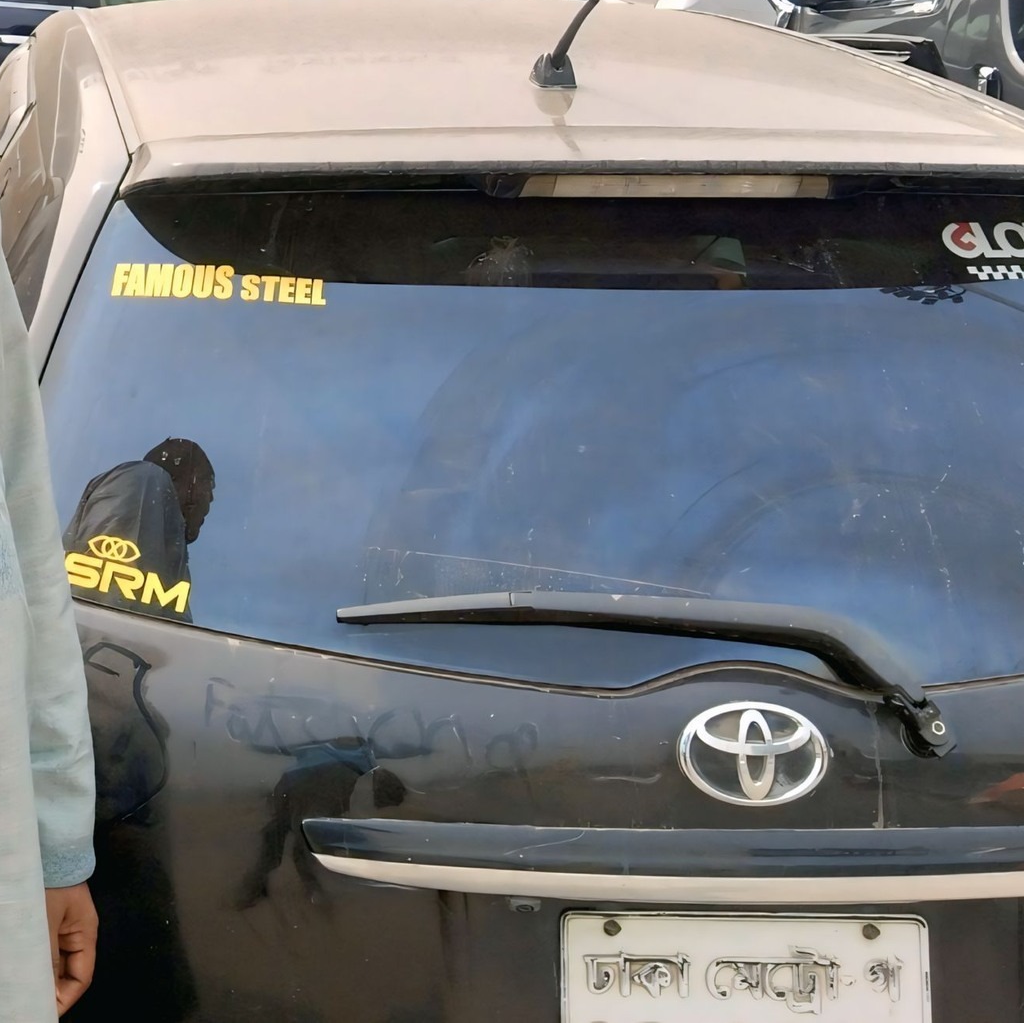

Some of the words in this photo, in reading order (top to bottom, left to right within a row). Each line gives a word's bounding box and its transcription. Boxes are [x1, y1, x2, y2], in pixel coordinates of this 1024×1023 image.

[111, 263, 235, 300] FAMOUS
[240, 274, 327, 306] STEEL
[64, 552, 191, 613] SRM
[583, 950, 692, 999] ঢাকা
